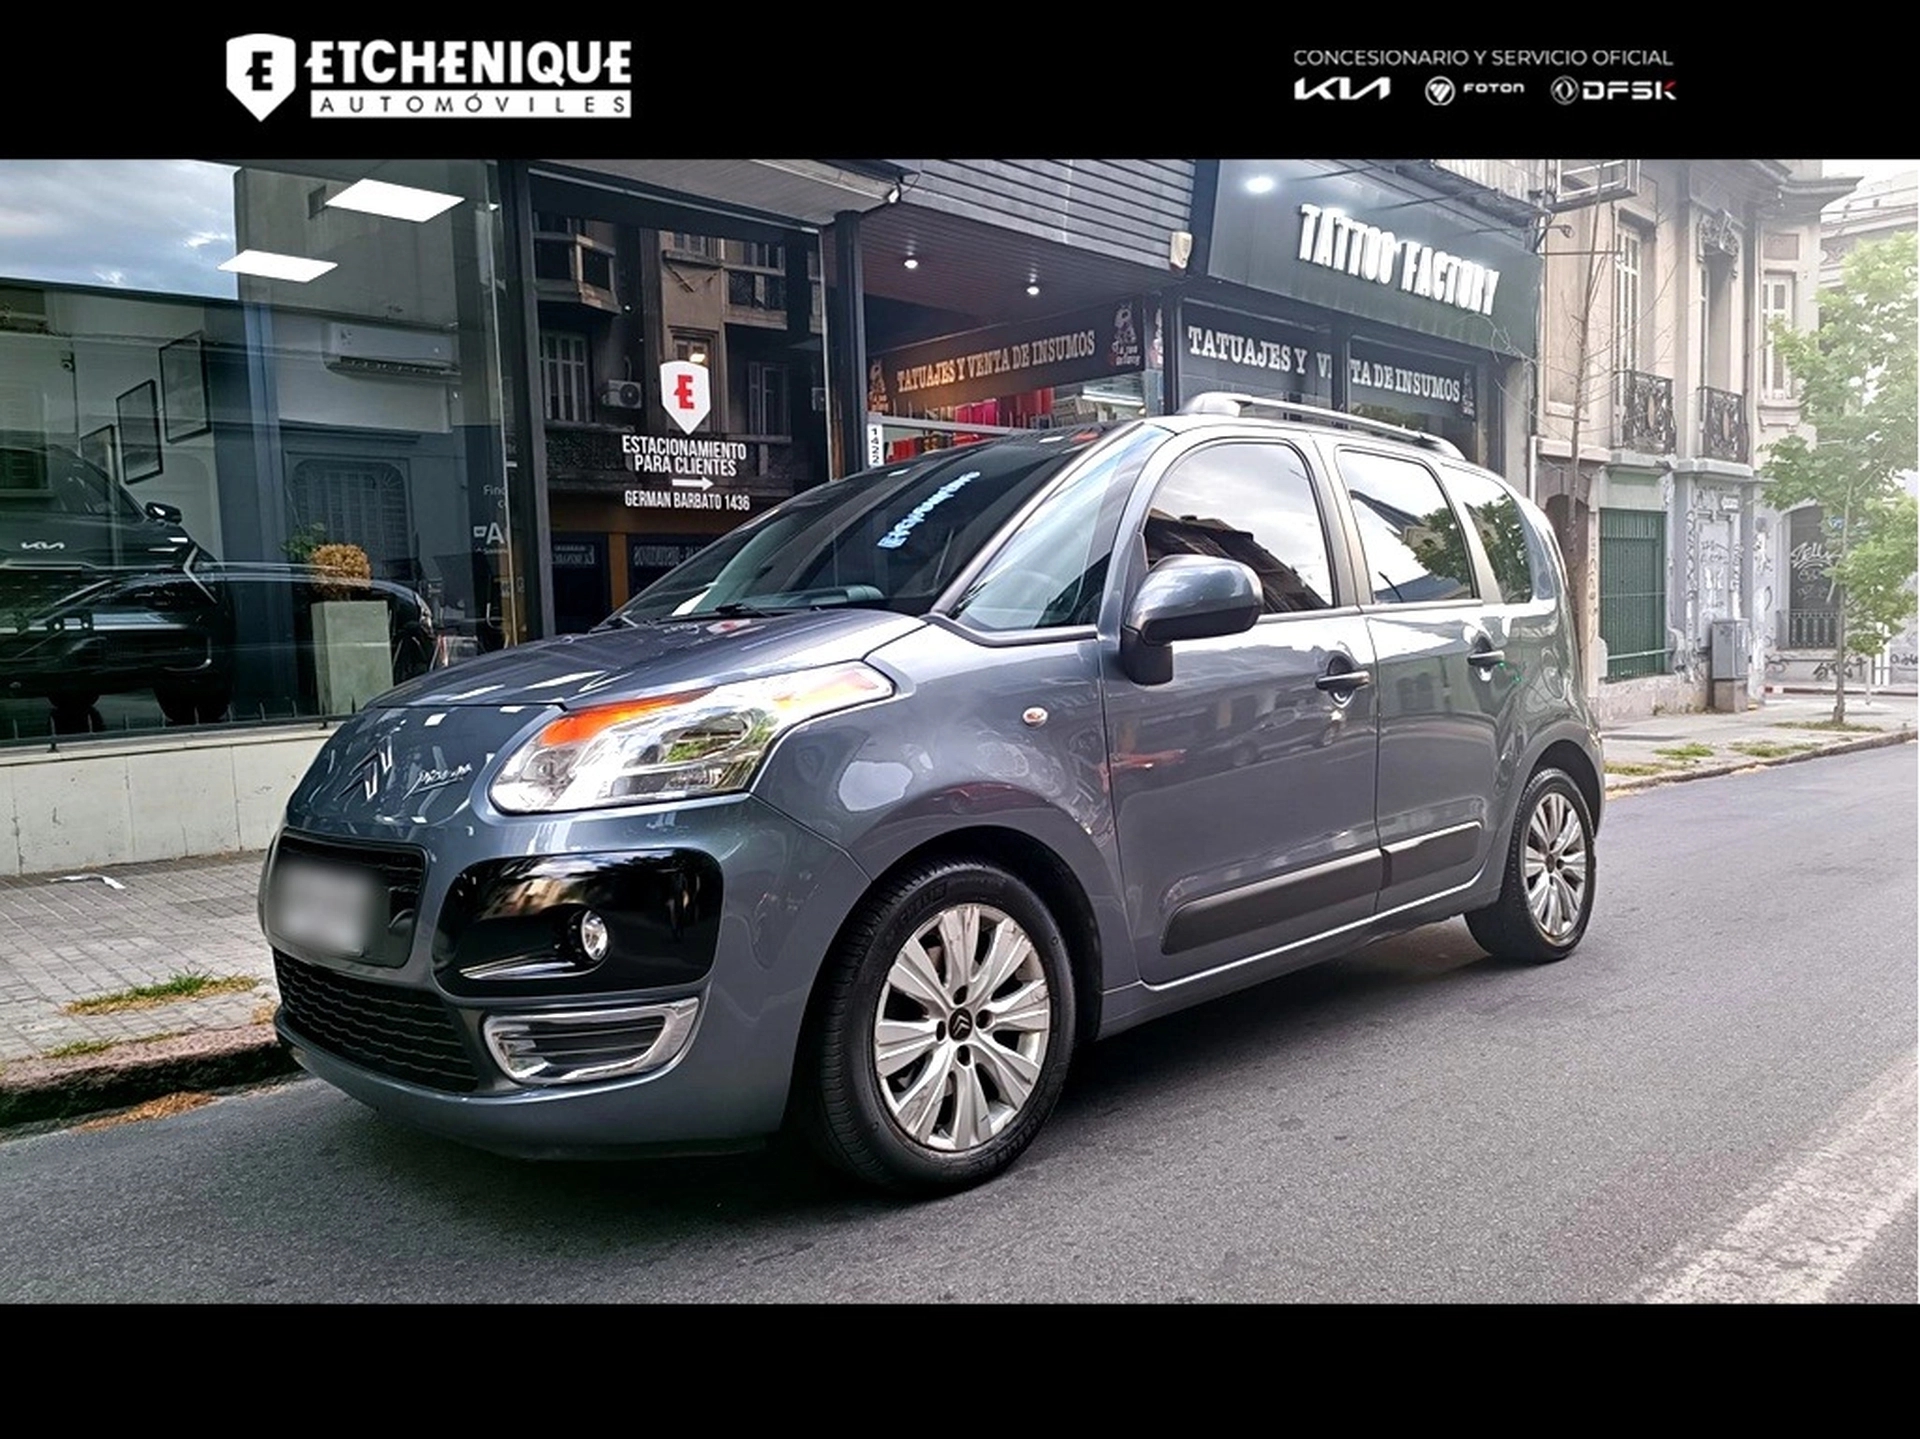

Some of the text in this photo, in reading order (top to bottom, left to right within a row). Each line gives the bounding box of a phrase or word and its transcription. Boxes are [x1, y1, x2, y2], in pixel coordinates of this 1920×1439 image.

[1299, 203, 1500, 316] TATTOO FACTORY
[897, 361, 956, 392] TATUAJES
[956, 359, 967, 382] Y
[967, 349, 1009, 377] VENTA
[1012, 343, 1030, 369] DE
[1031, 330, 1096, 365] INSUMOS
[1188, 325, 1291, 372] TATUAJES
[1293, 349, 1308, 375] Y
[1373, 366, 1394, 389] DE
[1395, 368, 1461, 403] INSUMOS
[622, 435, 747, 460] ESTACIONAMIENTO
[634, 454, 737, 476] PARA CLIENTES
[624, 490, 751, 511] GERMAN BARBATO 1436
